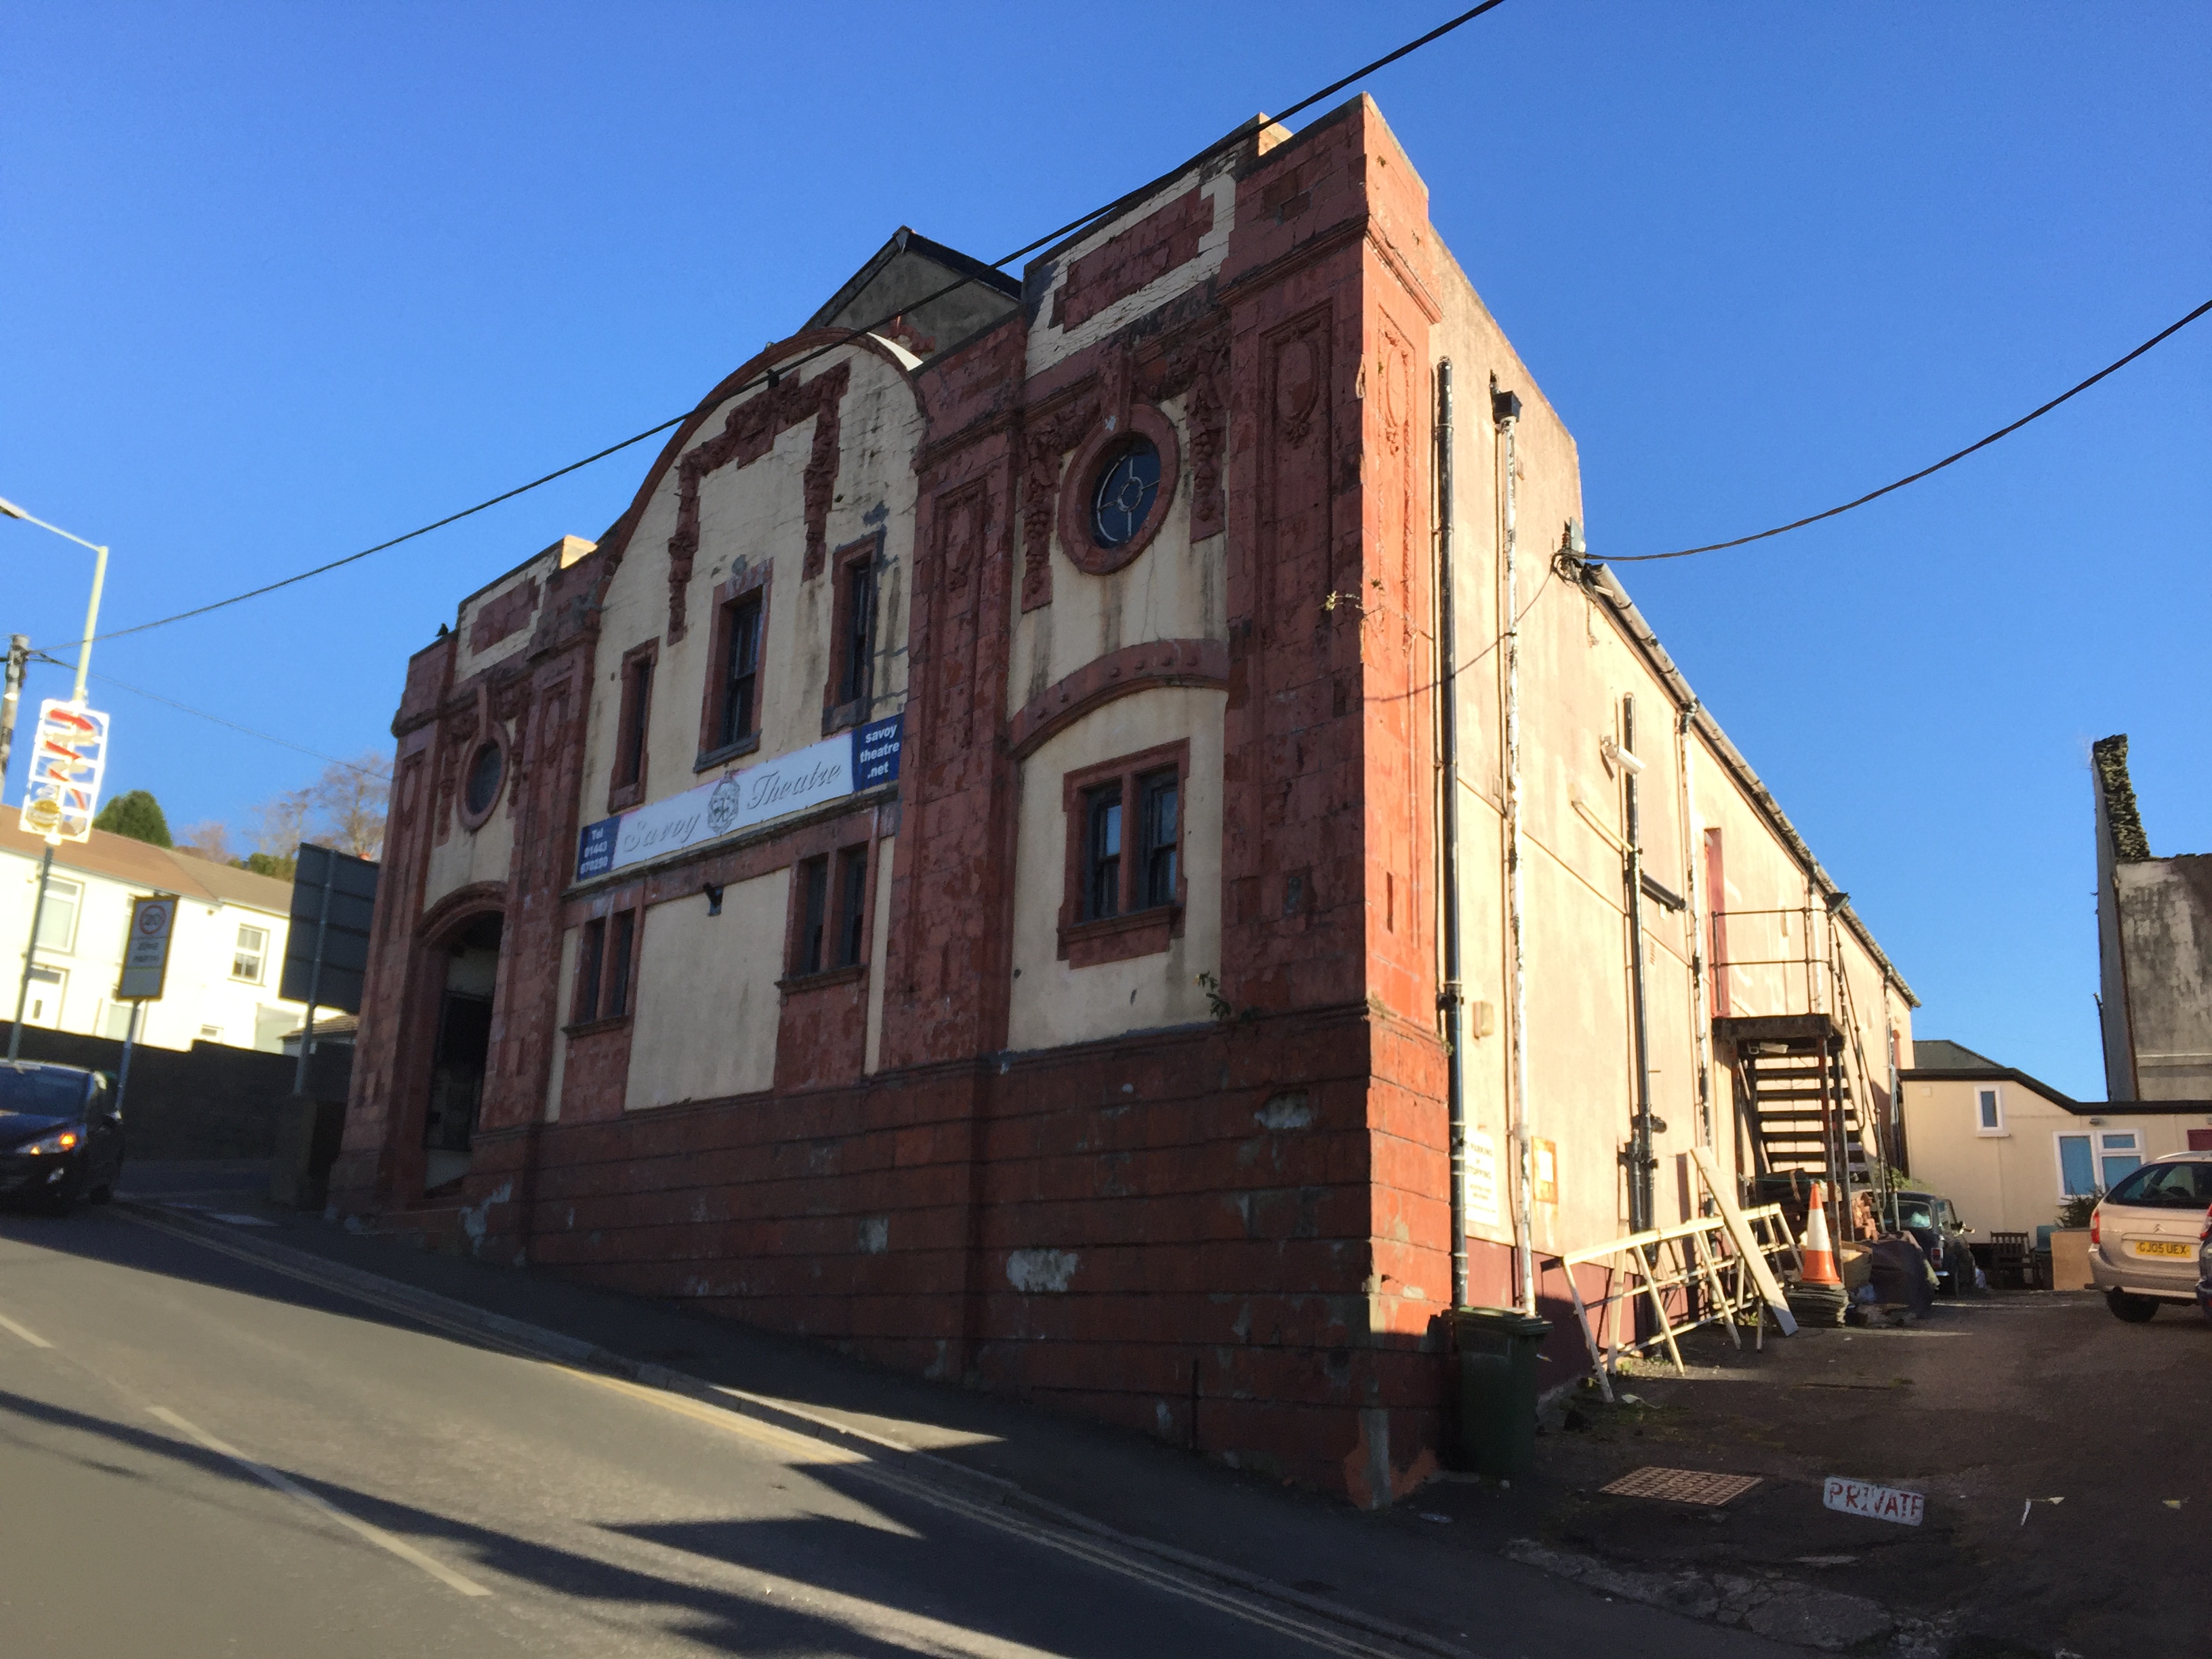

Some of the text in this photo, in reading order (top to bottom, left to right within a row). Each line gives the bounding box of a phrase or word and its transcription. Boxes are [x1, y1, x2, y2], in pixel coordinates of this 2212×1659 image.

[865, 724, 898, 743] savoy
[860, 742, 900, 763] theatre
[867, 760, 889, 779] .net
[623, 761, 842, 853] Savoy Theatre
[1830, 1481, 1923, 1517] PRIVATE
